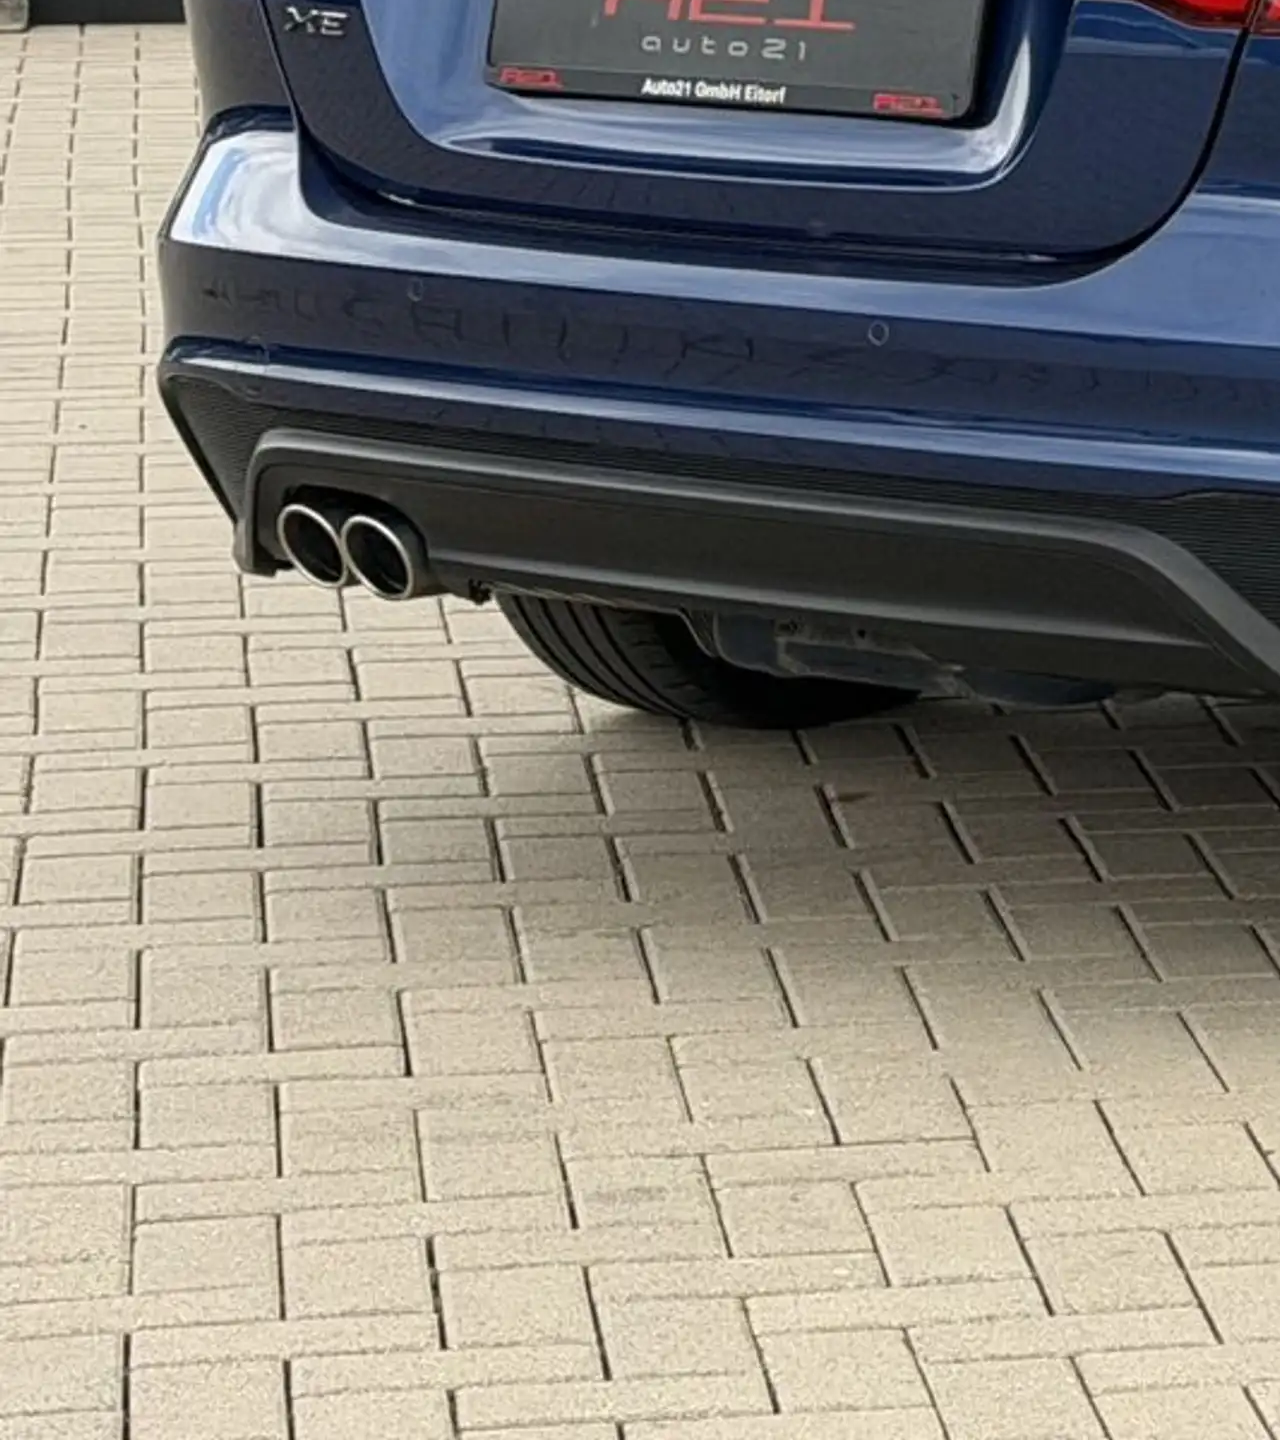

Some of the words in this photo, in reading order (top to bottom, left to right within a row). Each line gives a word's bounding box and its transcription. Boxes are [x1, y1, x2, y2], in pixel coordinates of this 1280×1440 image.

[284, 4, 350, 38] XE
[641, 77, 693, 98] Auto21
[694, 80, 742, 102] GmbH
[743, 83, 787, 105] Eitorf
